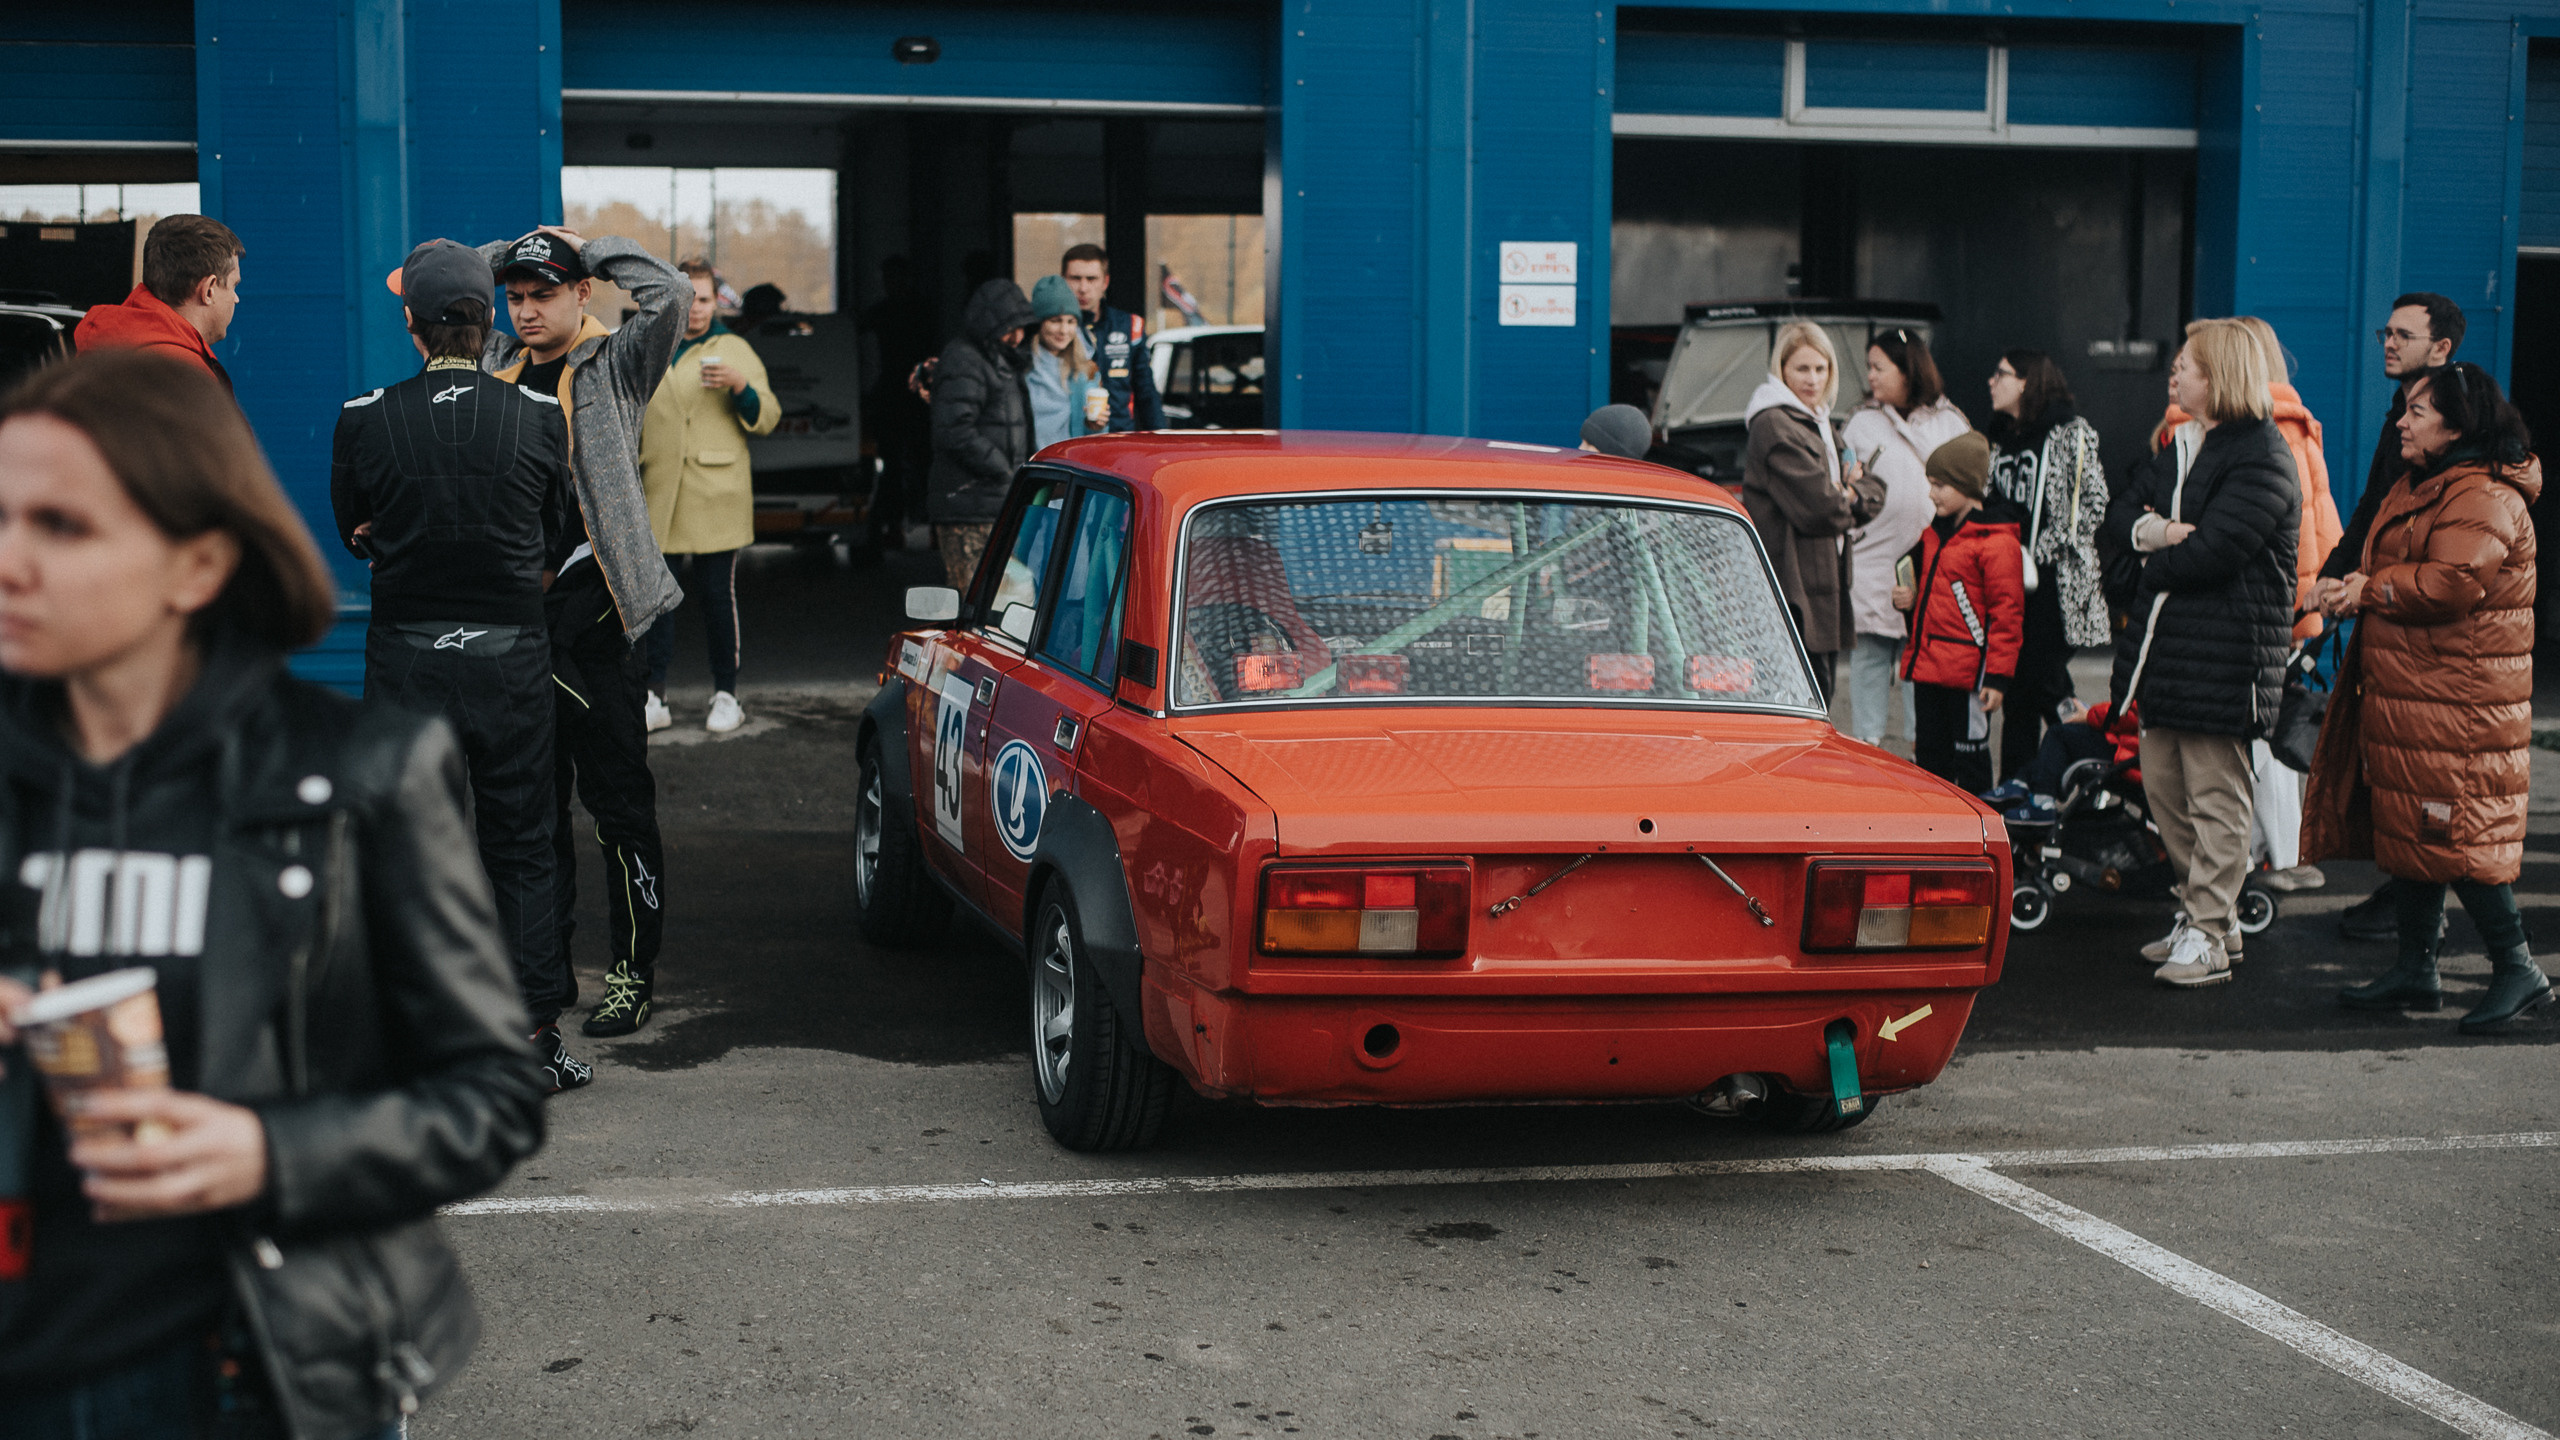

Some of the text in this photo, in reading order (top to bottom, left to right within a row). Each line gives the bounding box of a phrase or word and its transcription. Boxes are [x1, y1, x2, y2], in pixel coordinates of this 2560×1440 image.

[516, 244, 533, 256] Red
[533, 243, 552, 258] Bull
[936, 704, 963, 821] 43
